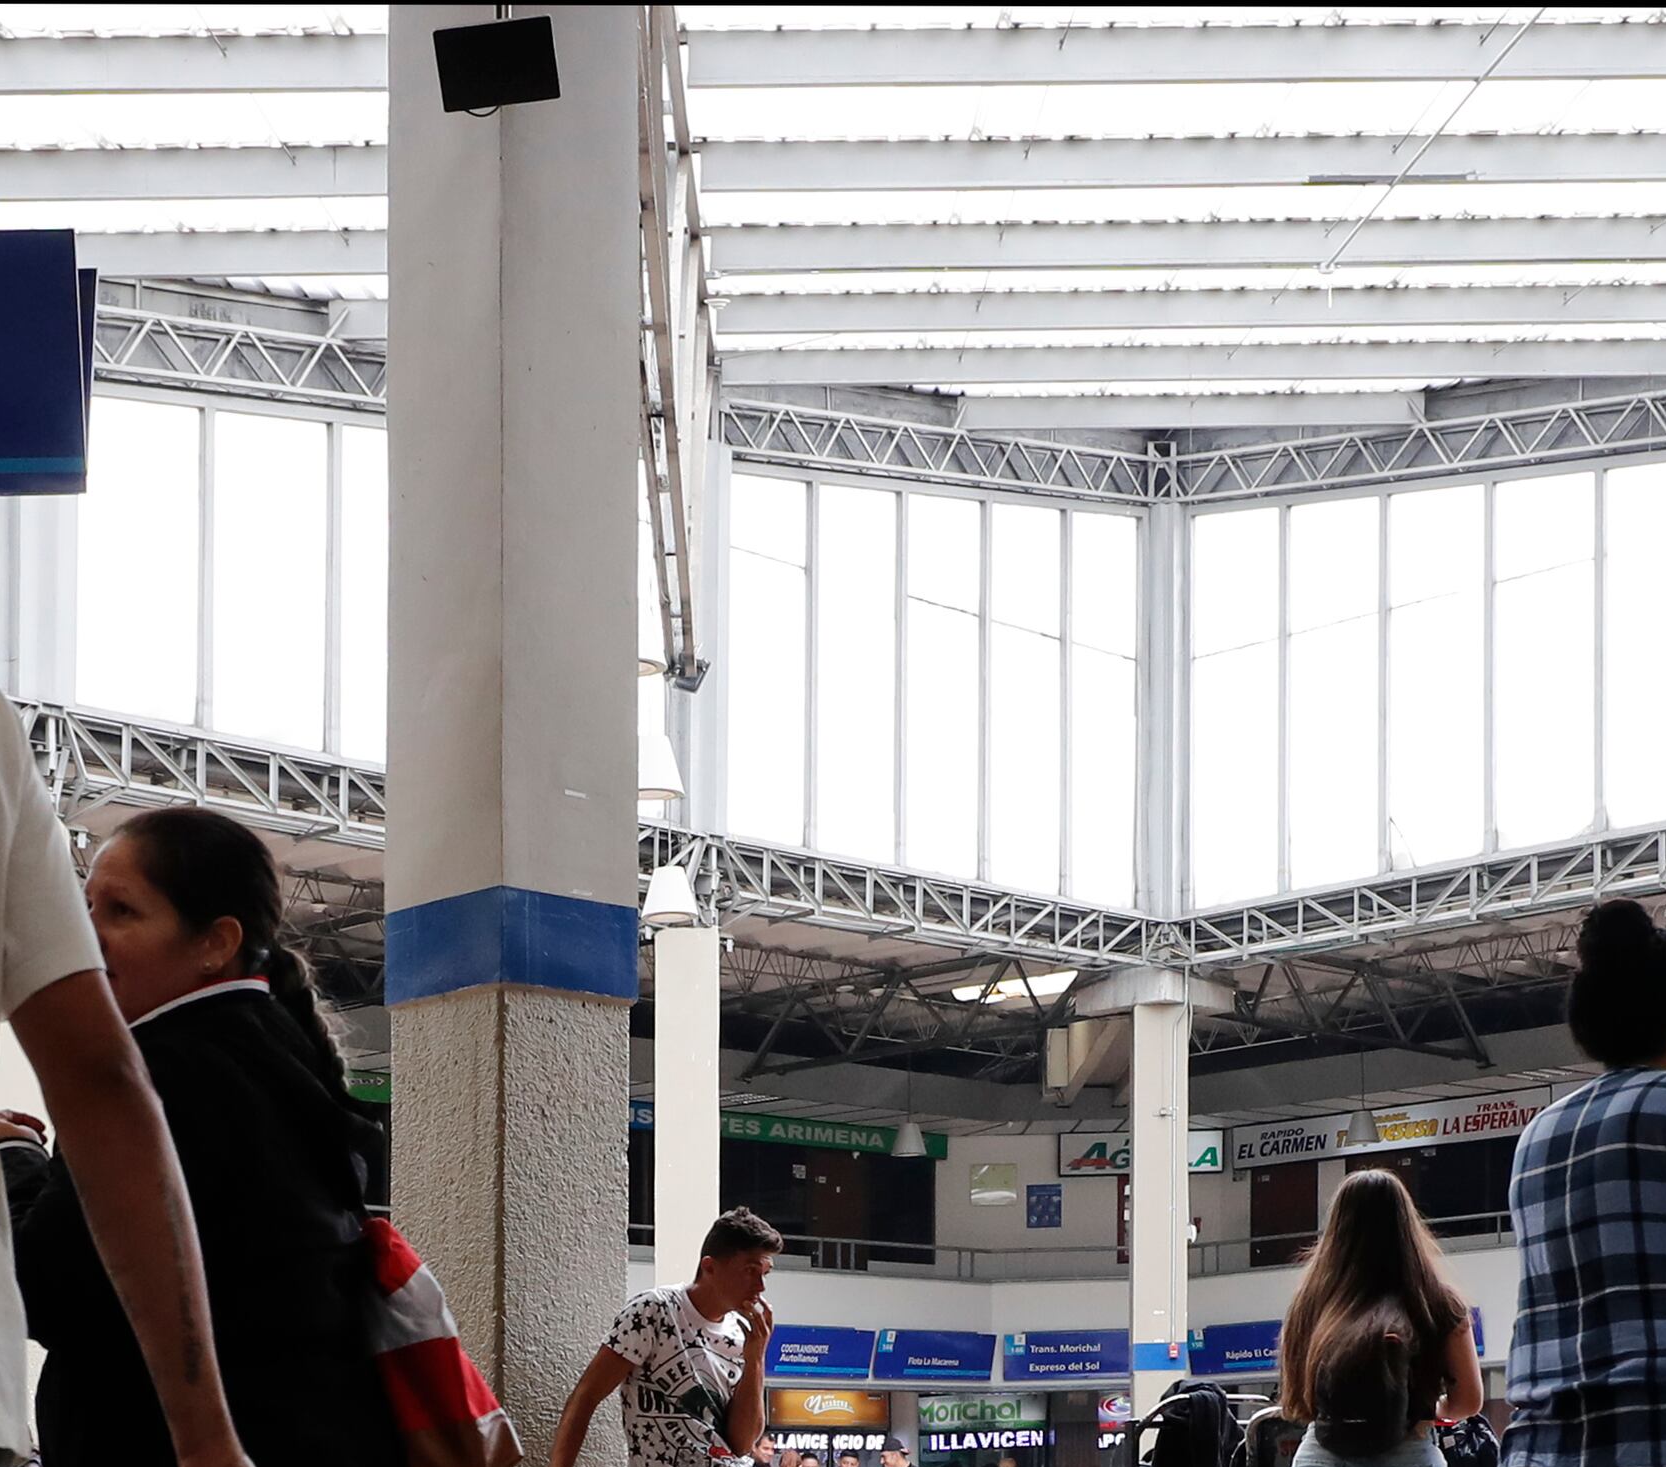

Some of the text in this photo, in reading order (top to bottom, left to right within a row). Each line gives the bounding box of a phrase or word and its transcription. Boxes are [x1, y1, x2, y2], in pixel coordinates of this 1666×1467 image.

[1475, 1099, 1518, 1112] TRANS.
[1442, 1105, 1547, 1136] LA ESPERANZ
[769, 1122, 884, 1148] ARIMENA
[1260, 1127, 1305, 1140] RAPIDO
[1237, 1133, 1328, 1160] EL CARMEN
[1029, 1343, 1101, 1354] Trans. Morichal
[1225, 1349, 1253, 1361] Rápido
[1029, 1361, 1100, 1374] Expreso del Sol
